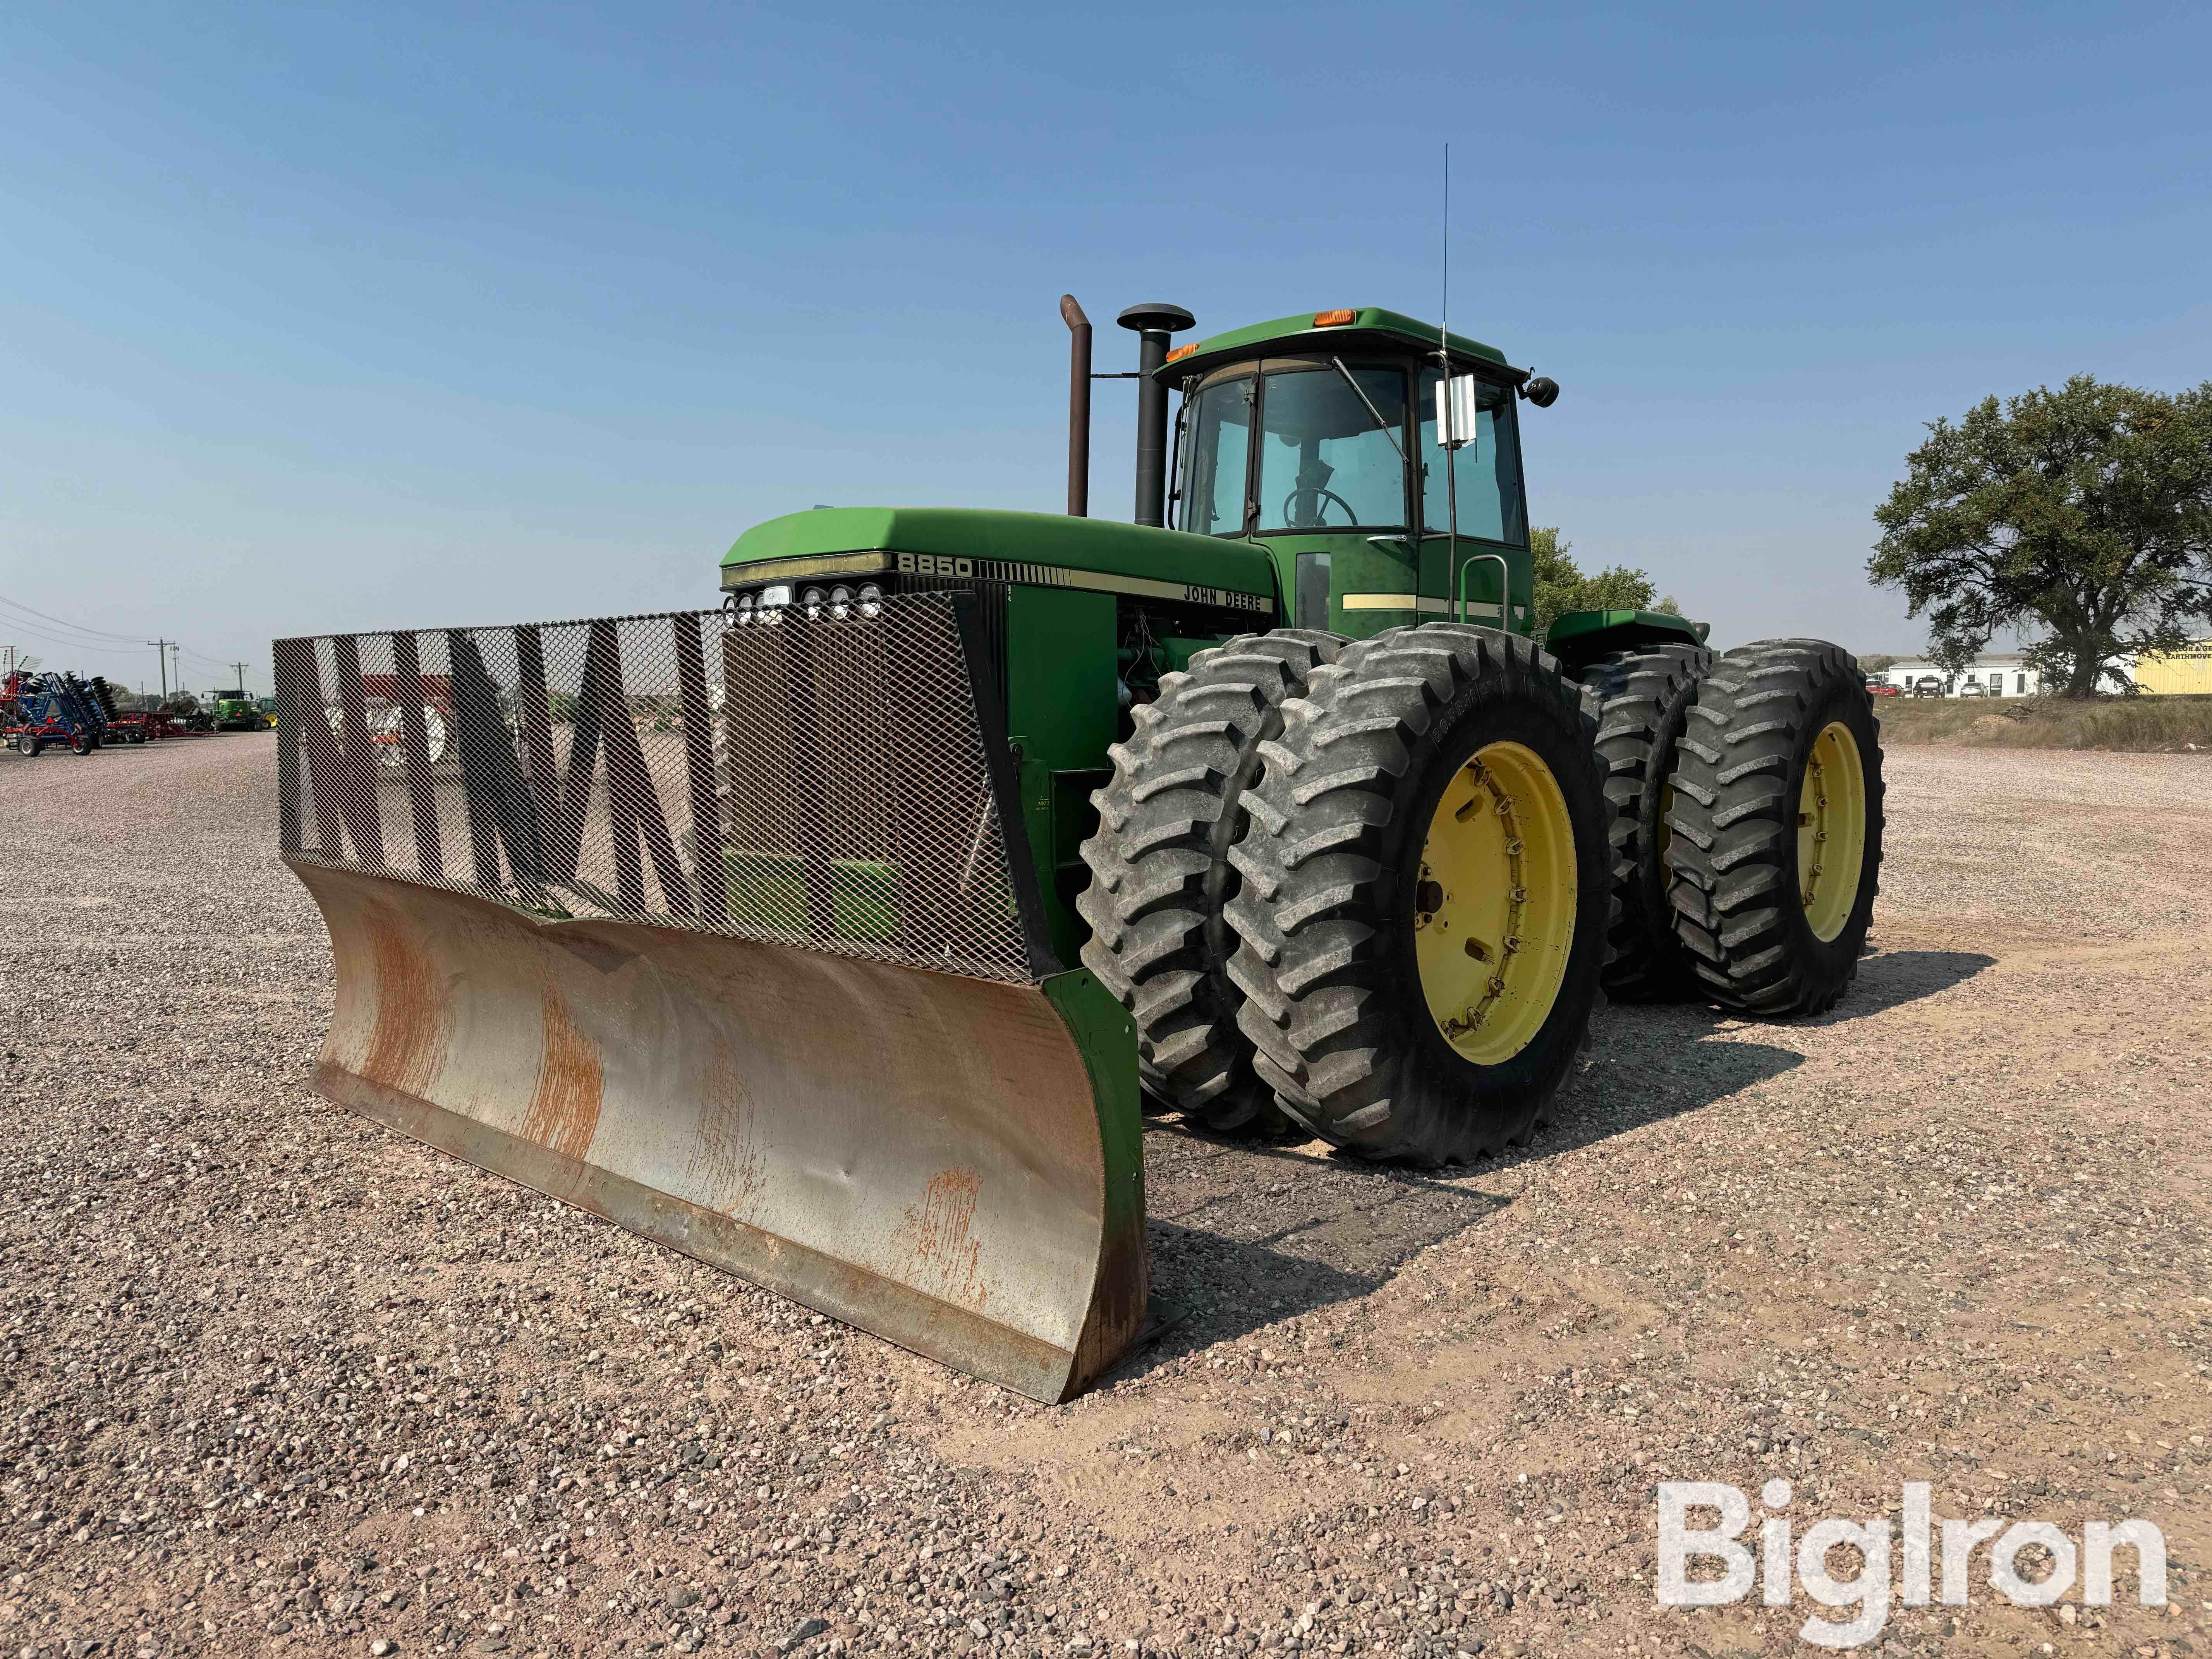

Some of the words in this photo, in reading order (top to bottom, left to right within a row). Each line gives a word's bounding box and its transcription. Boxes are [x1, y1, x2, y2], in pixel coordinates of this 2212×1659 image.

[898, 553, 972, 577] 8850
[1184, 585, 1217, 605] JOHN
[1225, 591, 1261, 611] DEERE
